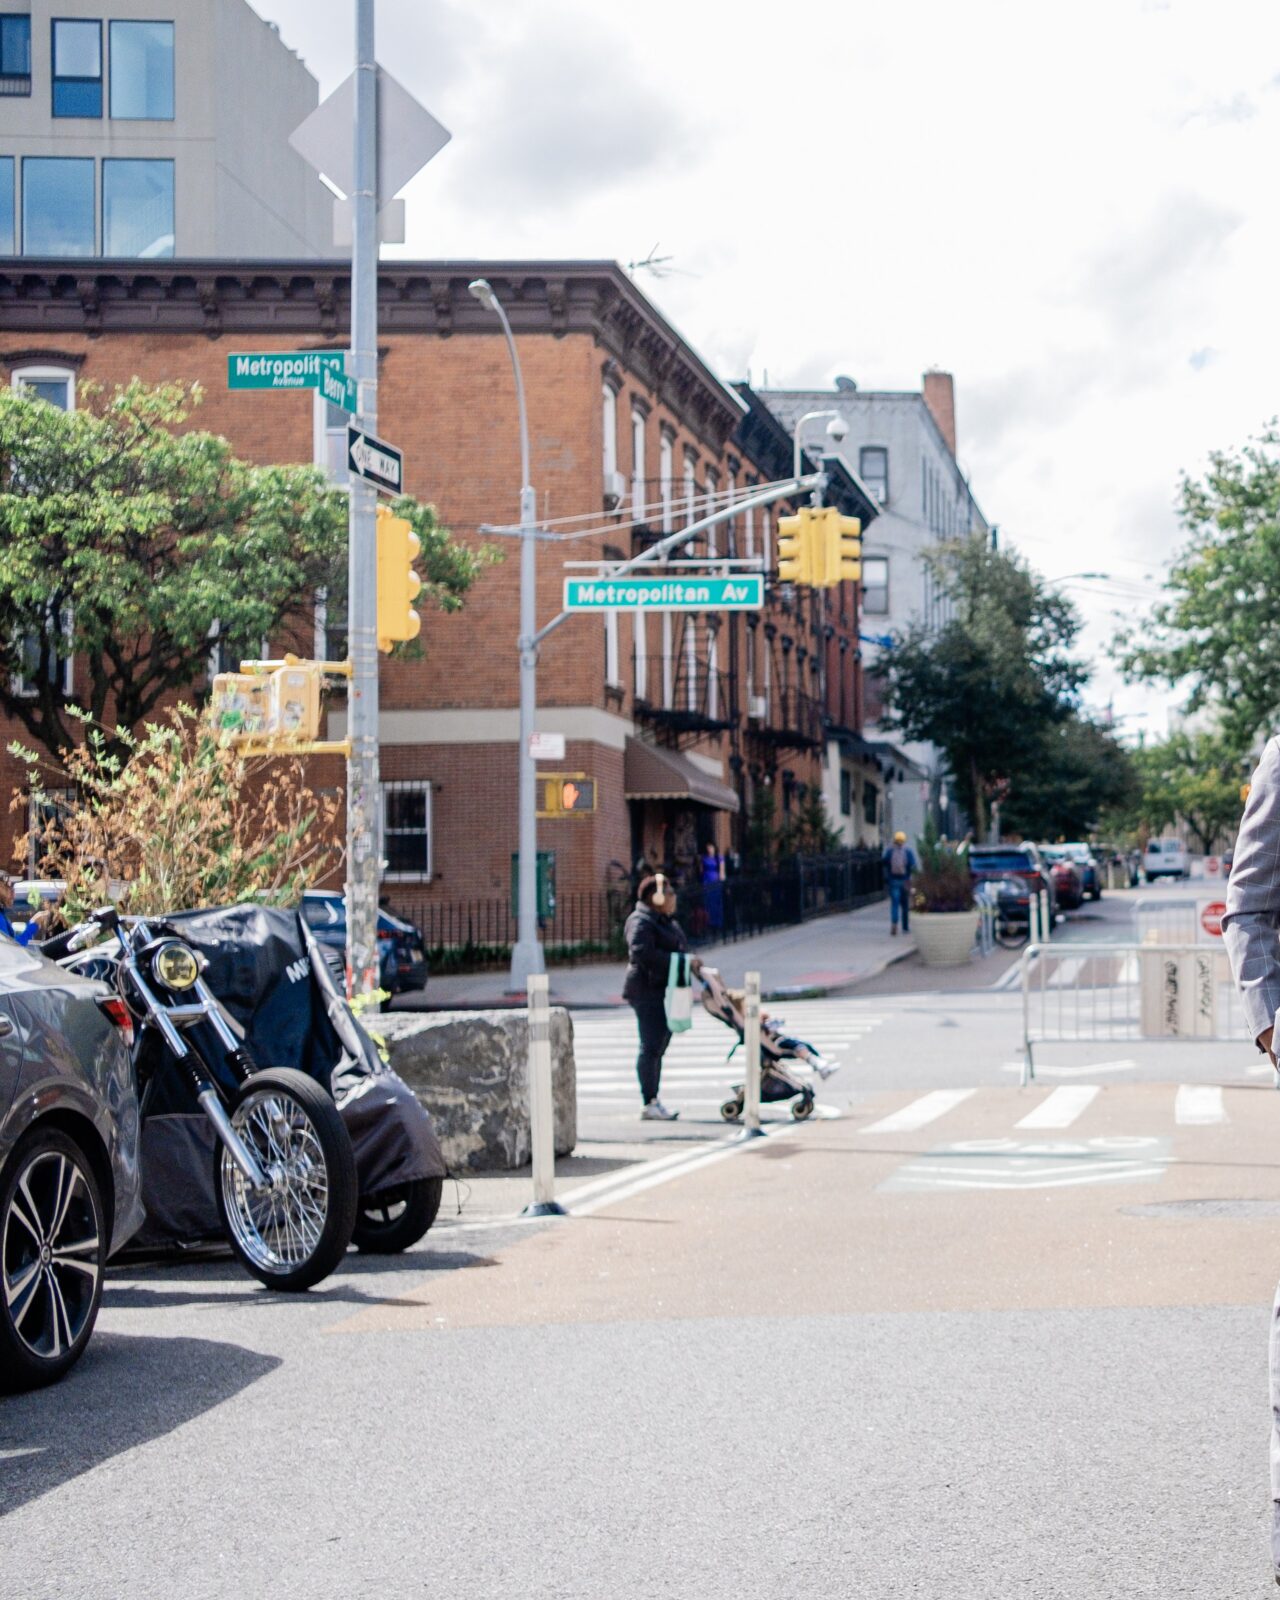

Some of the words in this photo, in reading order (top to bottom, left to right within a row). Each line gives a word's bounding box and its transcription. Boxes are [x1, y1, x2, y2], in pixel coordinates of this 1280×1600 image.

[272, 376, 305, 386] Avenue
[324, 367, 345, 408] Berry
[357, 445, 372, 466] ONE
[380, 458, 396, 479] WAY
[578, 584, 710, 605] Metropolitan
[721, 583, 749, 602] Av
